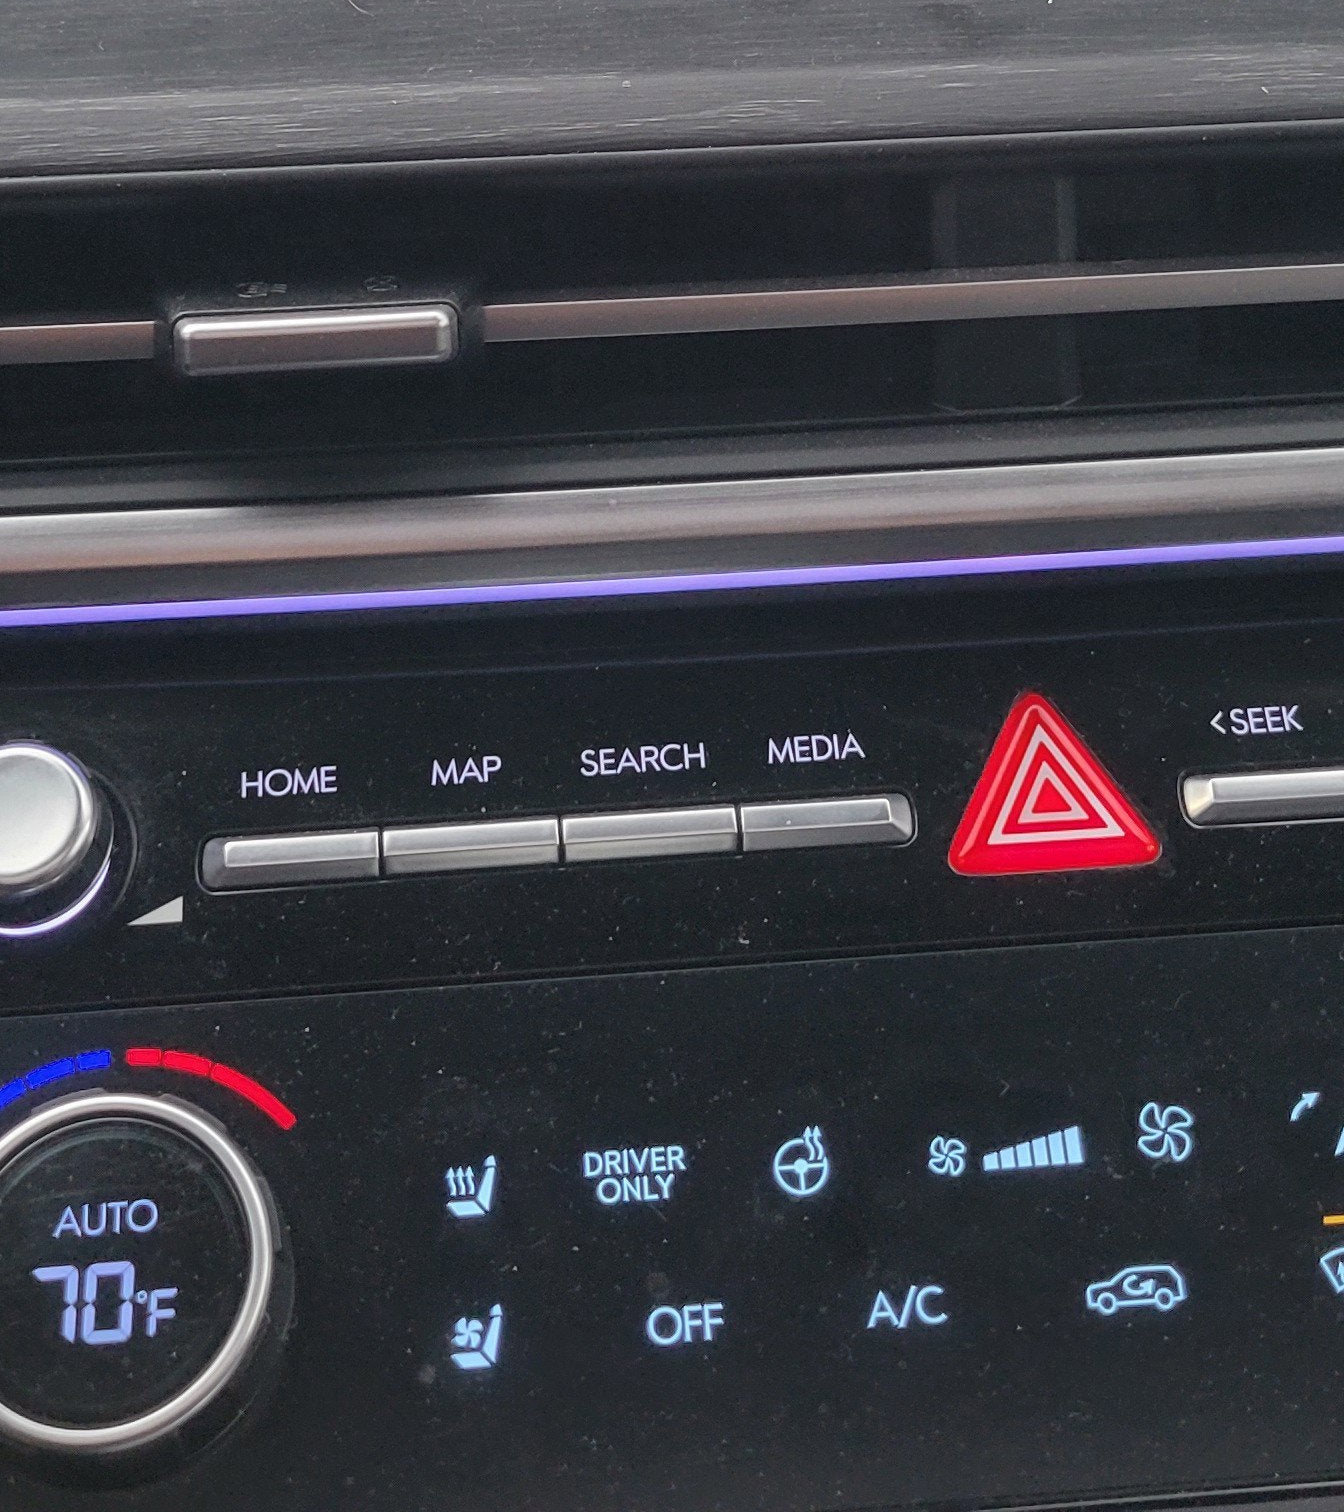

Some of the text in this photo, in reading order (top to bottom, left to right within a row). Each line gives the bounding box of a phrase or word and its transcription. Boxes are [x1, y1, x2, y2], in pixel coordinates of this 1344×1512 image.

[579, 741, 707, 778] SEARCH
[767, 731, 867, 765] MEDIA
[240, 764, 339, 800] HOME
[430, 754, 503, 787] MAP
[582, 1144, 688, 1179] DRIVER
[596, 1173, 676, 1206] ONLY
[51, 1198, 160, 1239] AUTO
[645, 1300, 726, 1347] OFF
[865, 1283, 949, 1329] A/C
